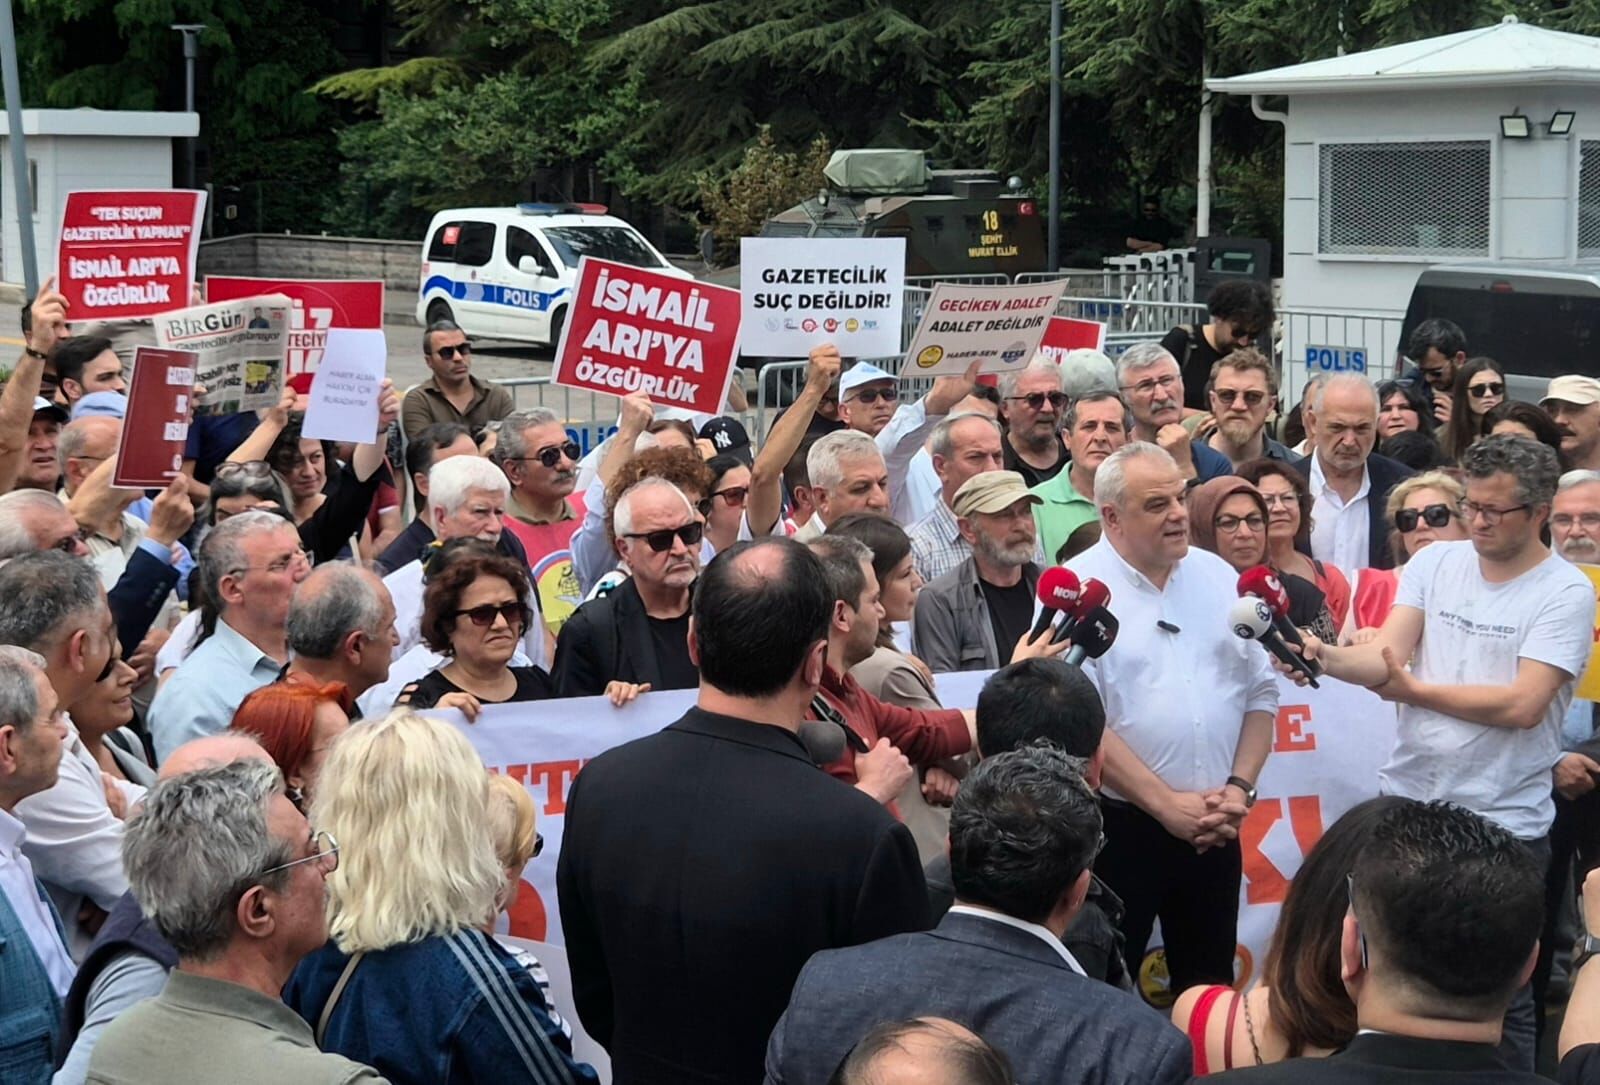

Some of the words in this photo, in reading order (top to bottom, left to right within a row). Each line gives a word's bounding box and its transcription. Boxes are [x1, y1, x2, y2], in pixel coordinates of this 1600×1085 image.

[122, 206, 162, 222] SUÇUM
[982, 210, 998, 230] 18
[63, 223, 136, 241] GAZETECİLİK
[69, 254, 126, 279] İSMAİL
[128, 256, 181, 276] ARI'YA
[762, 265, 888, 285] GAZETECİLİK
[83, 282, 171, 306] ÖZGÜRLÜK
[503, 288, 540, 309] POLİS
[592, 268, 714, 332] İSMAİL
[753, 293, 792, 312] SUÇ
[798, 290, 891, 310] DEĞİLDİR!
[939, 298, 1000, 312] GECİKEN
[1002, 296, 1052, 310] ADALET
[929, 320, 982, 332] ADALET
[984, 316, 1044, 332] DEĞİLDİR
[582, 318, 704, 373] ARI'YA
[575, 356, 700, 404] ÖZGÜRLÜK
